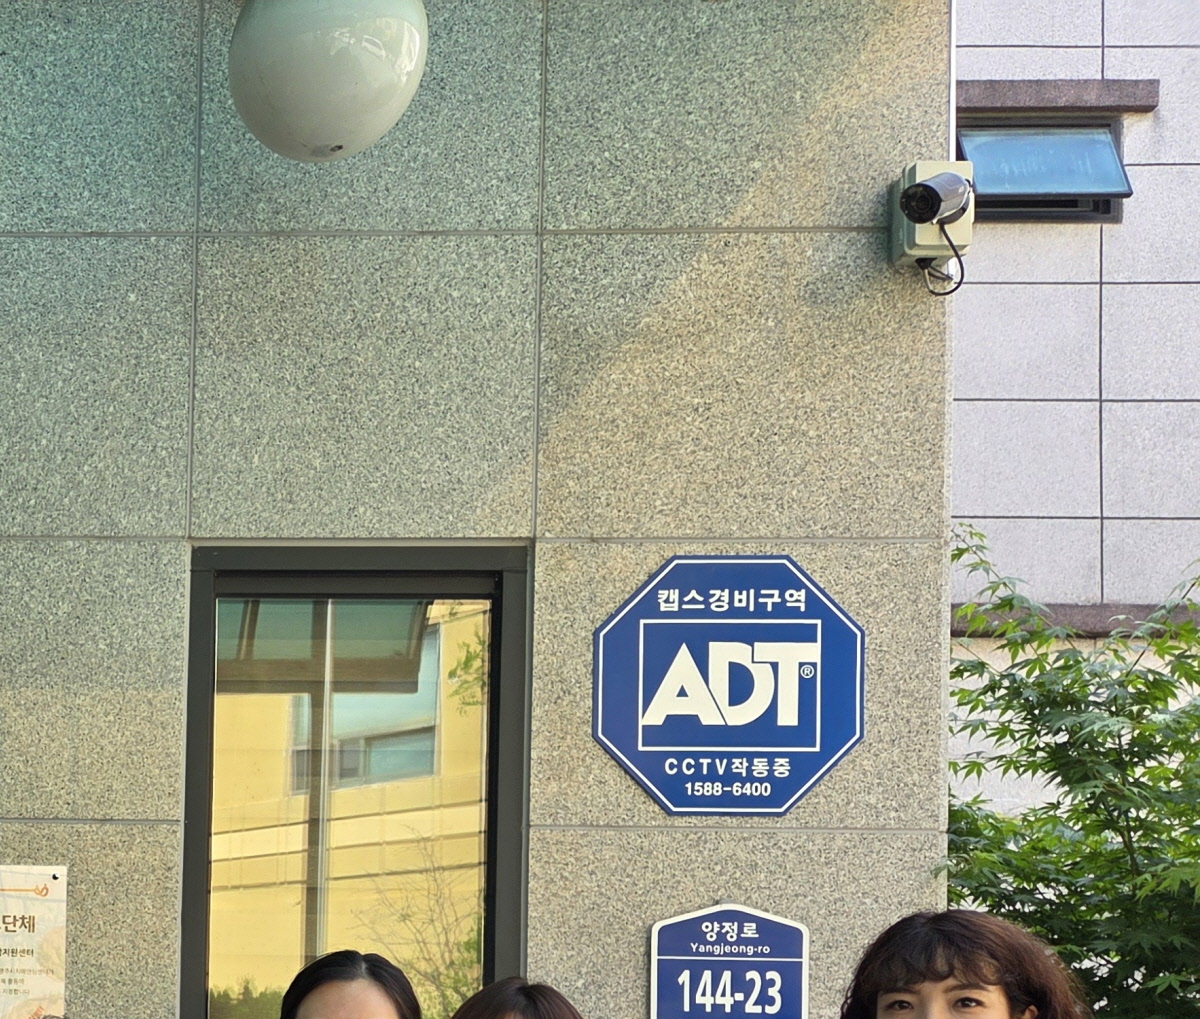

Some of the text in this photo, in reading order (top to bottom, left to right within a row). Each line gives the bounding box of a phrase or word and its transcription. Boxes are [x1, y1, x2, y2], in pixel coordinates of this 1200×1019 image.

[657, 588, 806, 612] 캡스경비구역
[641, 641, 819, 726] ADT
[664, 758, 791, 777] CCTV작동중
[685, 782, 771, 796] 1588-6400
[701, 921, 759, 942] 양정로
[690, 942, 771, 955] Yangjeong-ro
[677, 969, 782, 1015] 144-23
